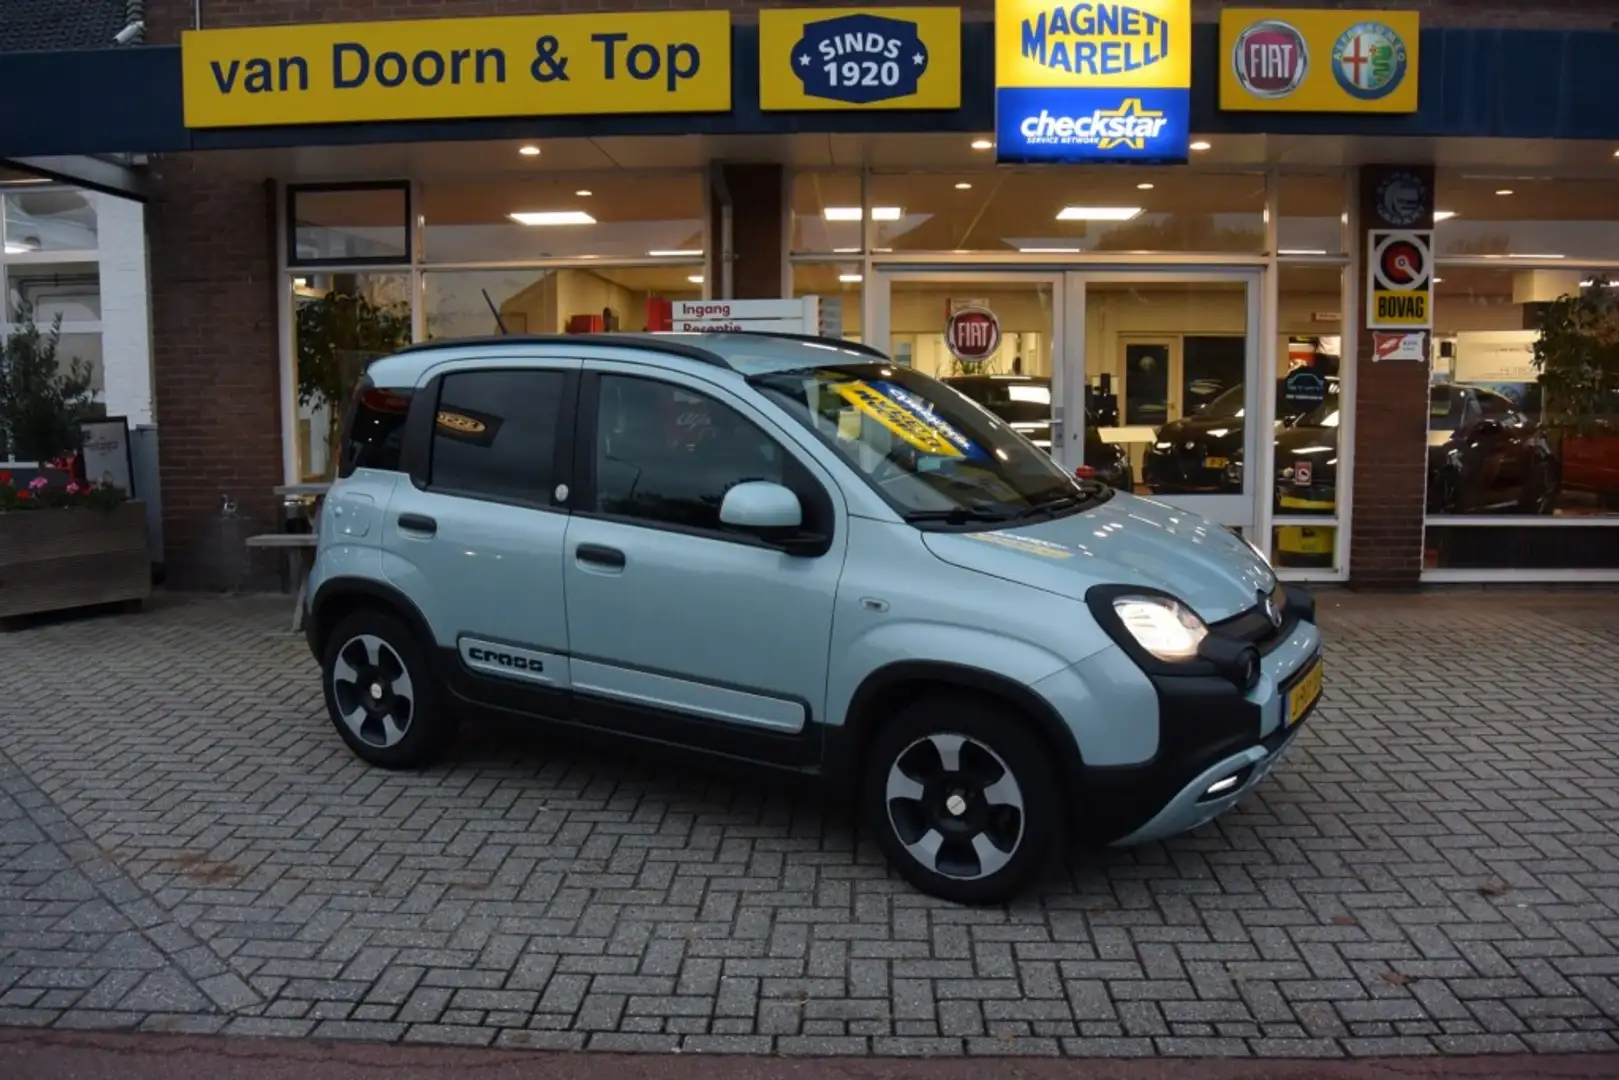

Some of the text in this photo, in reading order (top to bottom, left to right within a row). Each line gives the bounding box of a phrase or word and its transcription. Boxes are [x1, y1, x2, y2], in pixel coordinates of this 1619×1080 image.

[1021, 3, 1168, 55] MAGNETI
[818, 32, 902, 60] SINDS
[210, 33, 700, 95] van Doorn & Top
[823, 61, 900, 86] 1920
[1250, 43, 1293, 79] FIAT
[1020, 109, 1167, 138] checkstar
[1026, 136, 1099, 145] SERVICE NETWORK
[683, 303, 730, 318] Ingang
[1378, 295, 1424, 318] BOVAG
[957, 322, 989, 347] FIAT
